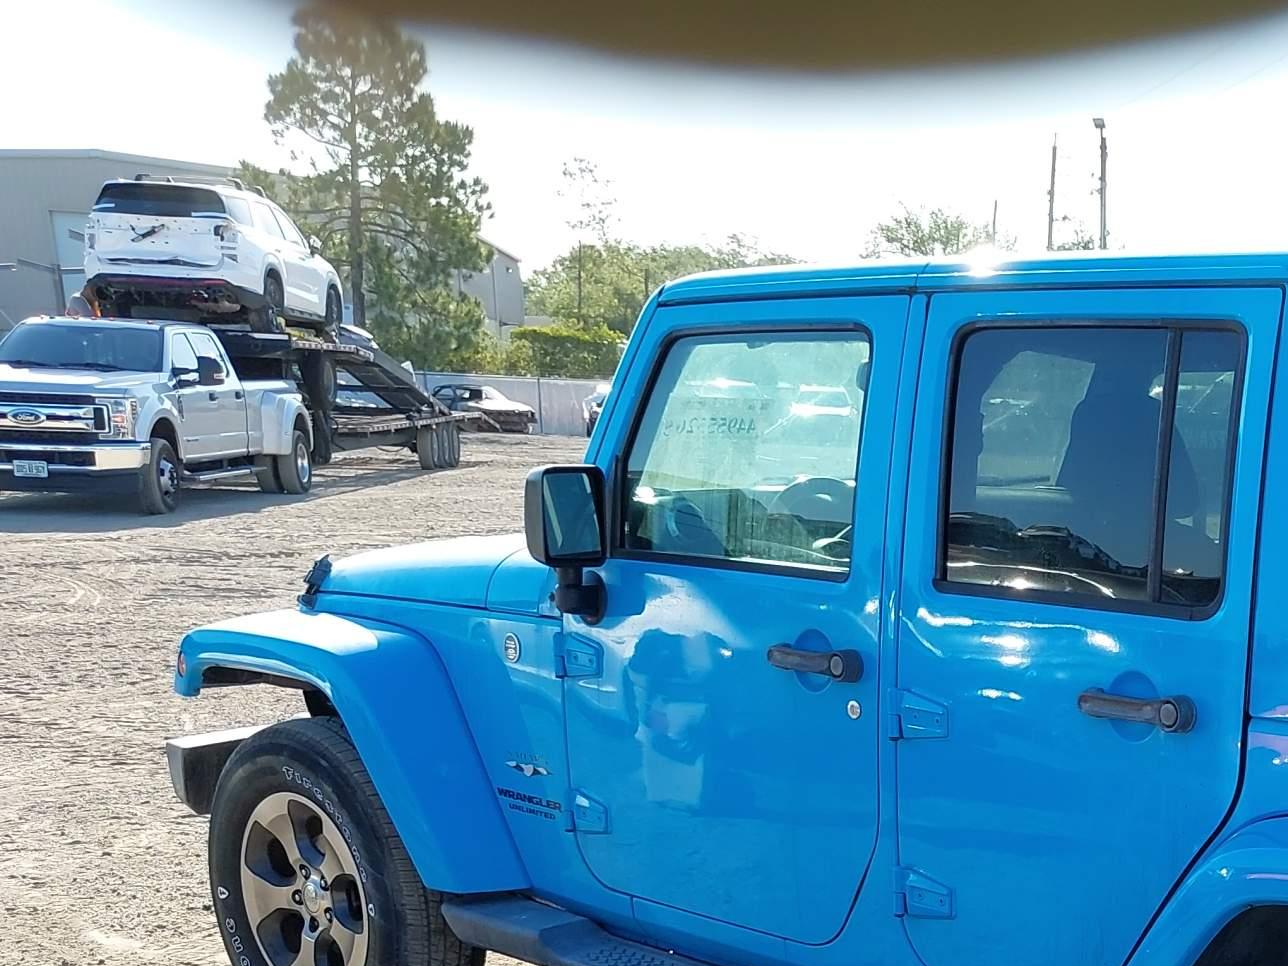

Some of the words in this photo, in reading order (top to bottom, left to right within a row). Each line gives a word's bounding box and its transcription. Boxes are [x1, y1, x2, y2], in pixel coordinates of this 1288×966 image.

[496, 787, 562, 812] WRANGLER
[508, 803, 556, 820] UNLIMITED
[282, 766, 368, 884] Firestone
